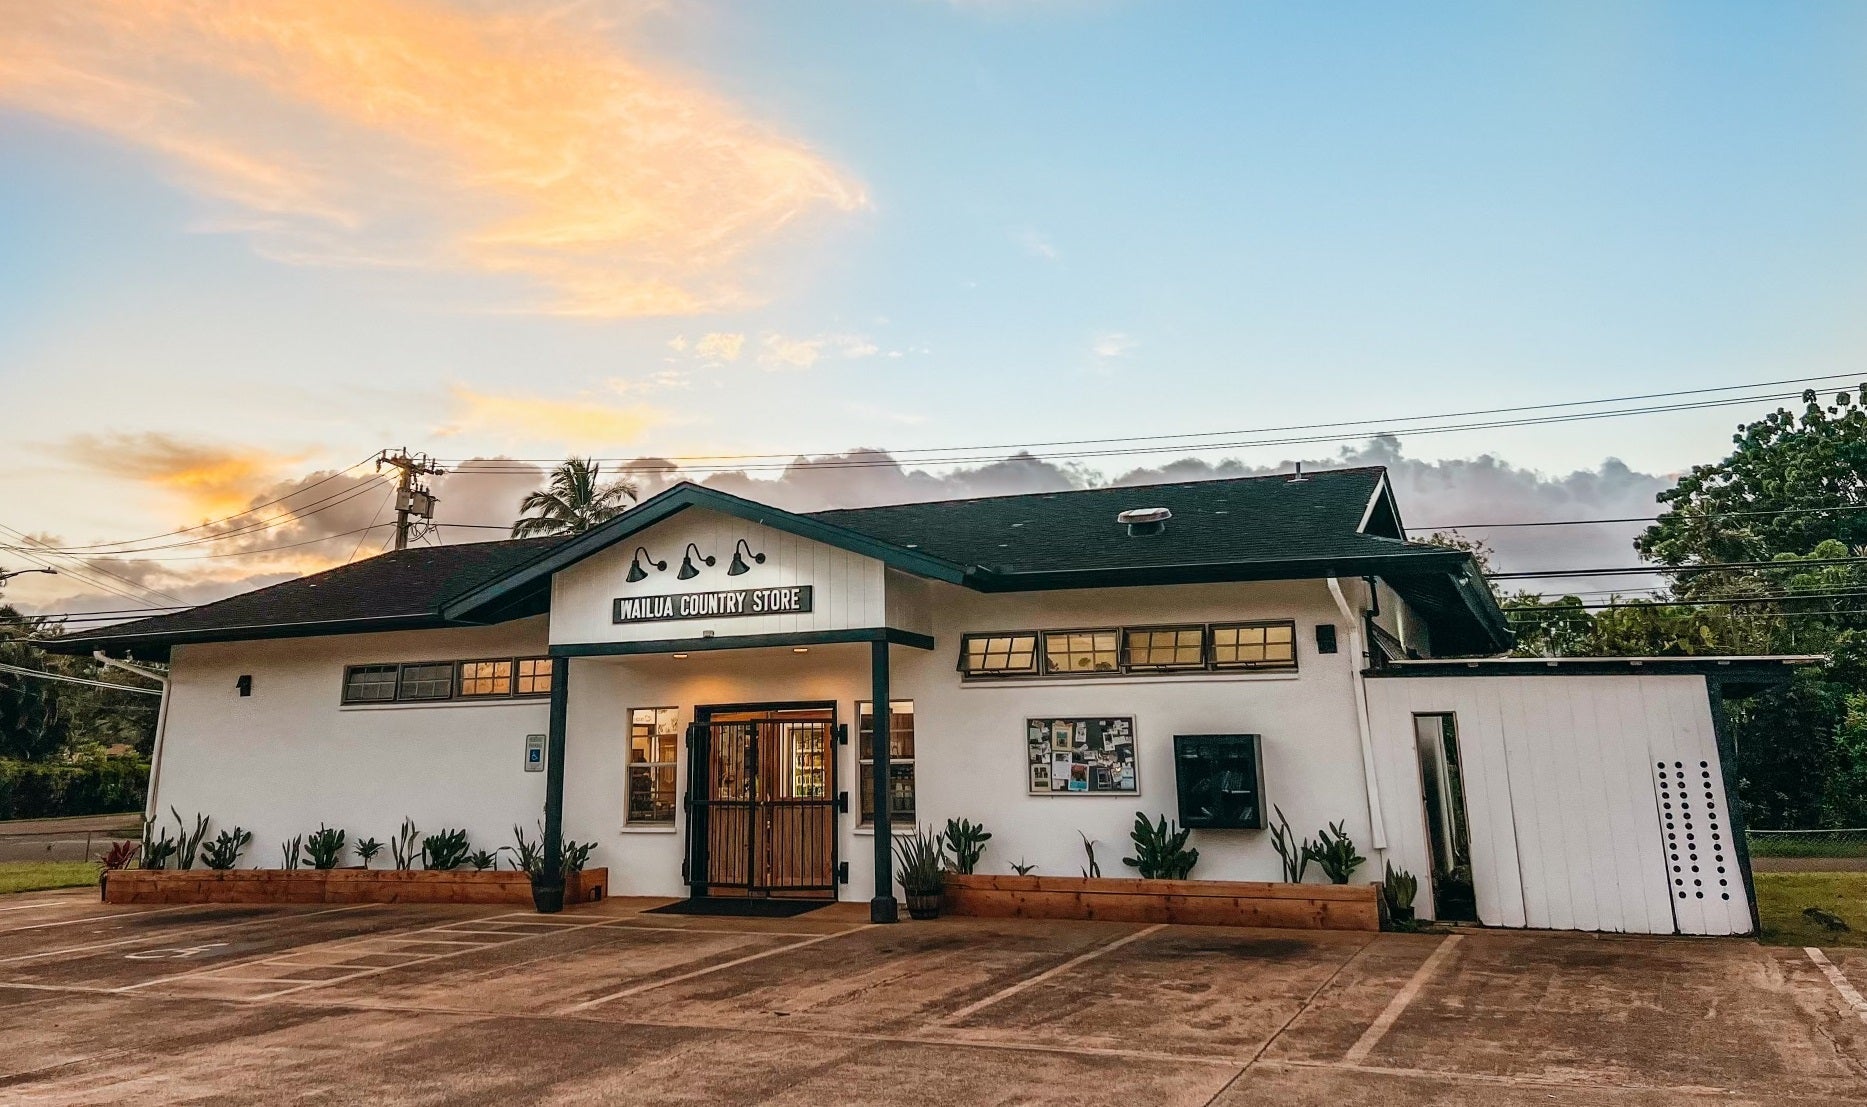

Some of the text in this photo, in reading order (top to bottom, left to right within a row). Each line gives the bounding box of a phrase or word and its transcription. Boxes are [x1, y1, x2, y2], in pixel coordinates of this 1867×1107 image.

[620, 588, 800, 619] WAILUA COUNTRY STORE
